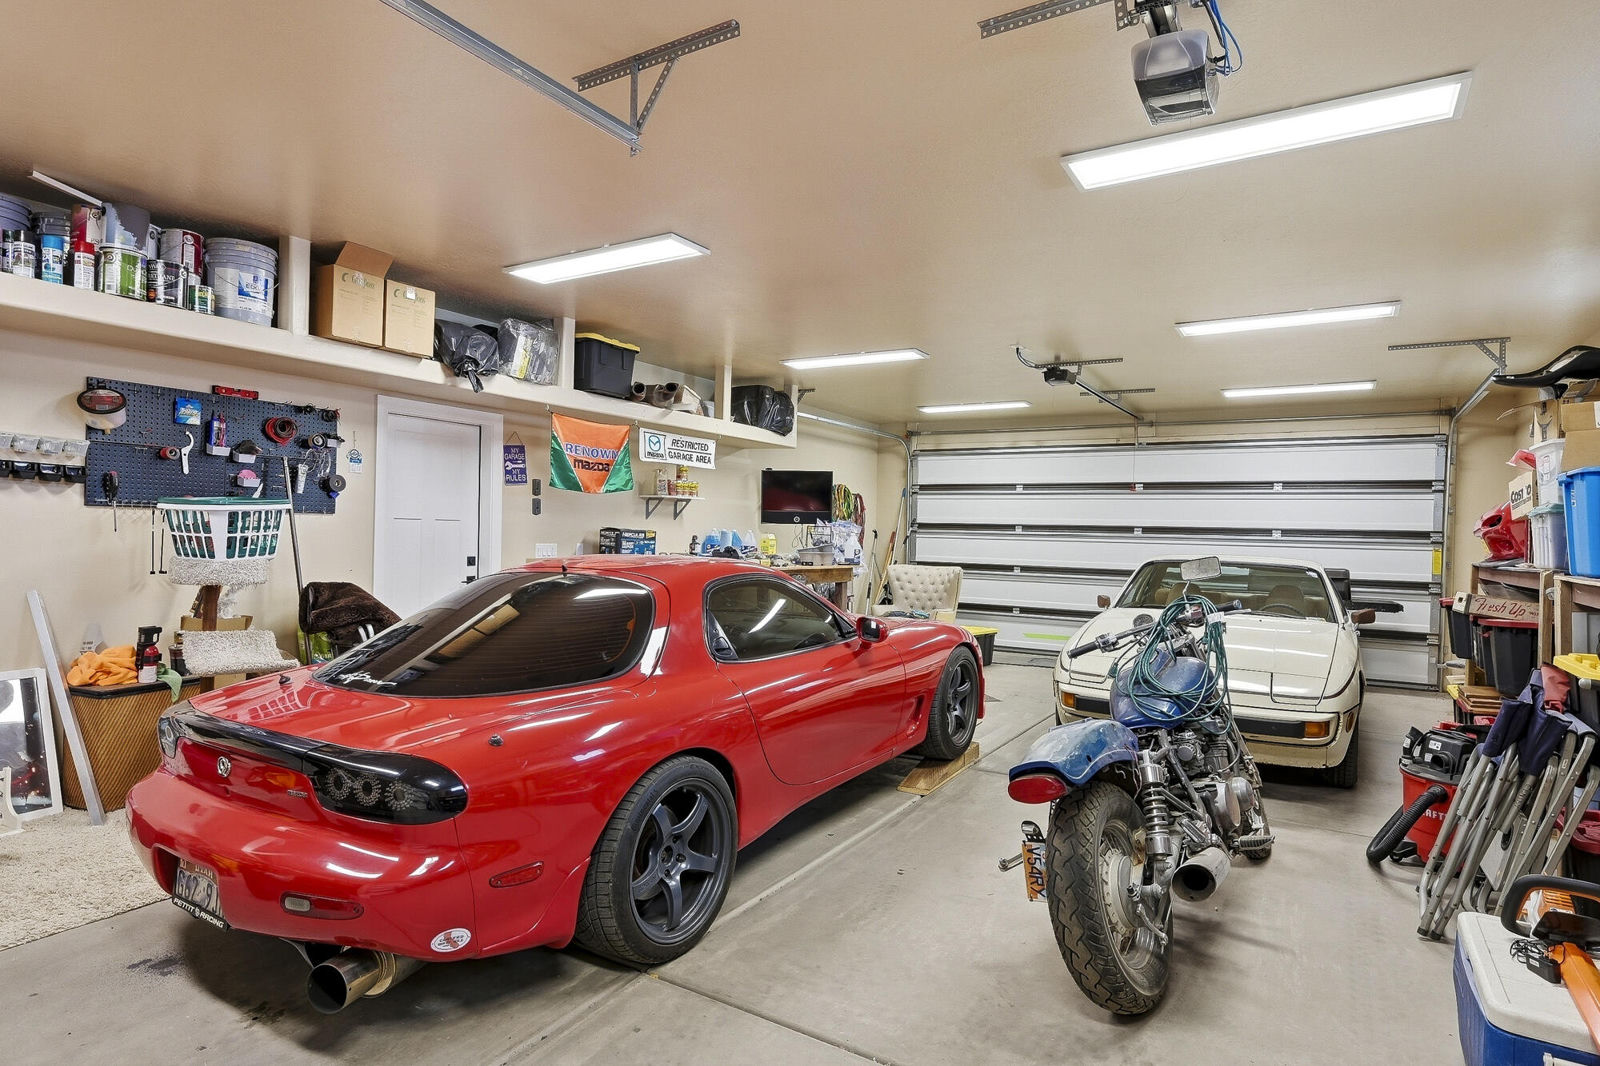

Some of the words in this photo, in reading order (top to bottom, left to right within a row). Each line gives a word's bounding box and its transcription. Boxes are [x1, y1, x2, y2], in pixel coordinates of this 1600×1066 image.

[565, 443, 619, 459] RENOWN
[671, 438, 709, 452] RESTRICTED
[504, 453, 525, 461] GARAGE
[668, 450, 694, 462] GARAGE
[695, 454, 712, 464] AREA
[573, 458, 610, 473] mazda
[505, 474, 526, 482] RULES
[1510, 484, 1531, 504] COSTO
[1475, 597, 1508, 614] Fresh
[1508, 602, 1526, 618] Up
[1027, 847, 1046, 897] V54RY
[173, 897, 195, 913] PETTIT
[199, 911, 225, 928] RACING
